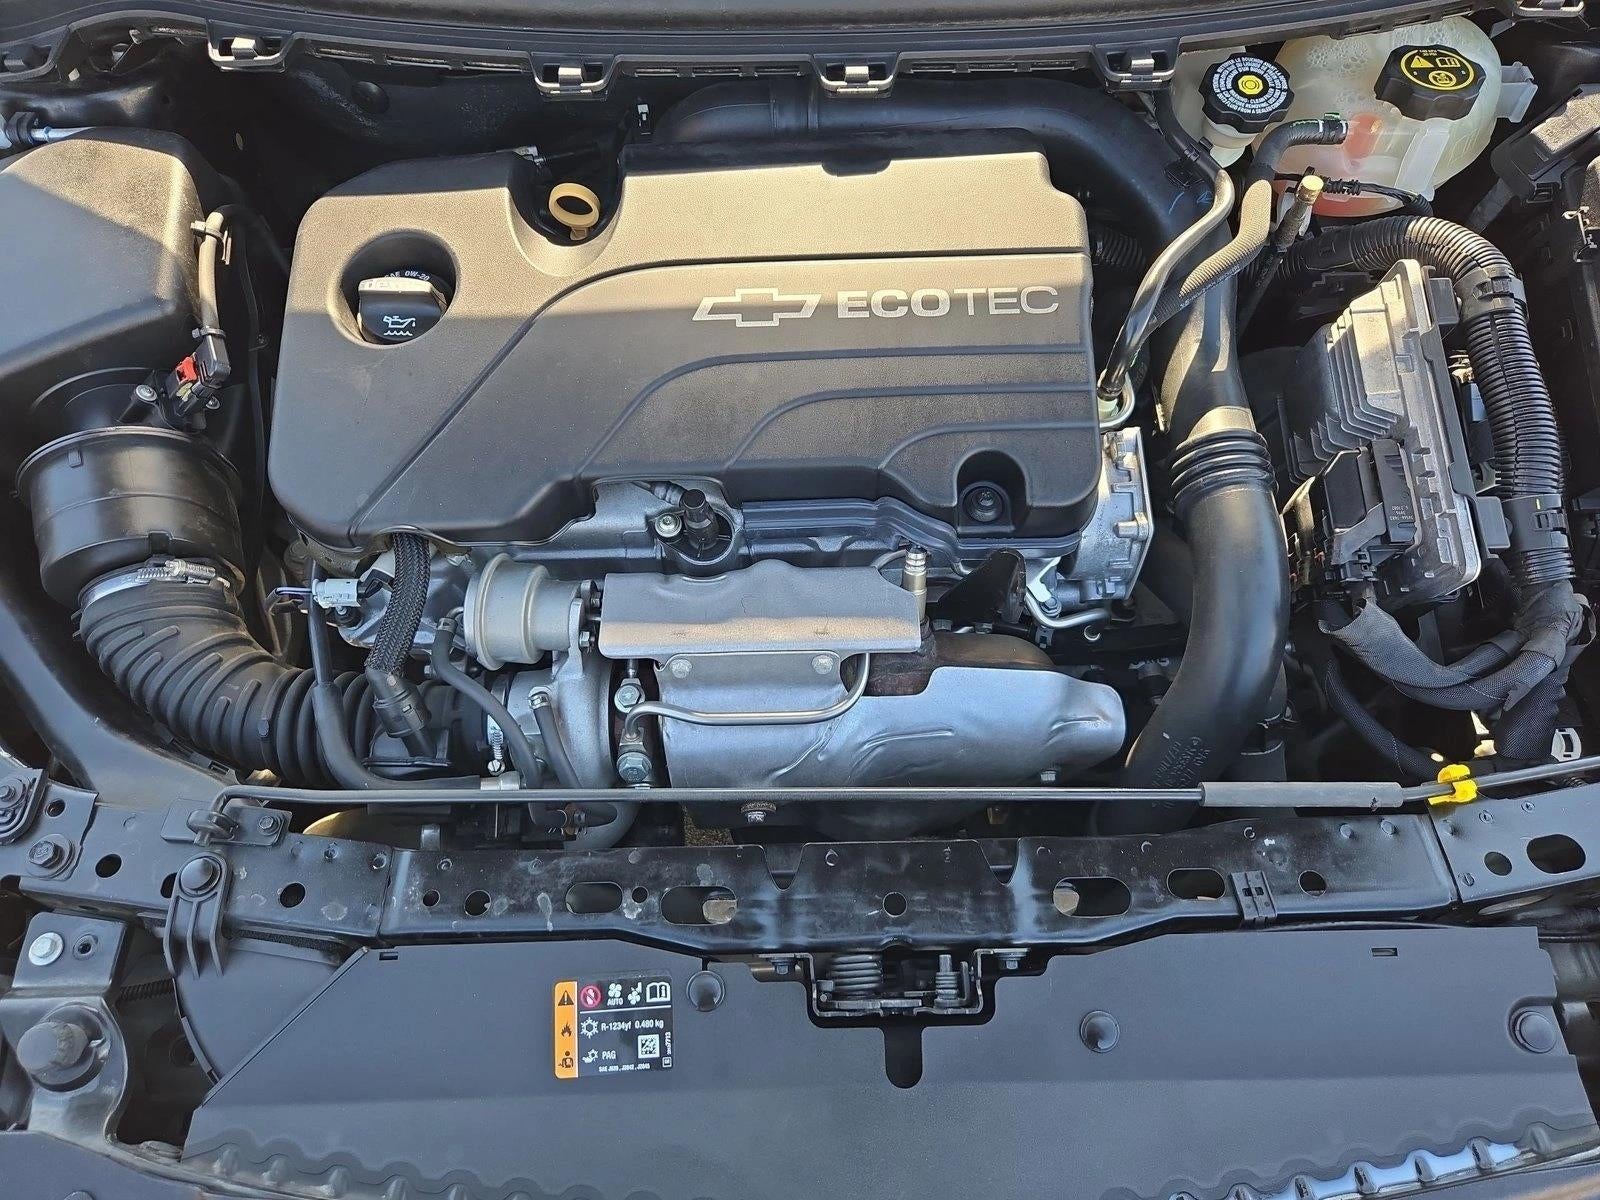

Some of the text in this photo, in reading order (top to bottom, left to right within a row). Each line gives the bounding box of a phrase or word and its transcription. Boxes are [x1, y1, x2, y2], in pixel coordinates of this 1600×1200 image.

[404, 270, 430, 281] 0W-20
[837, 286, 1059, 318] ECOTEC
[607, 998, 624, 1006] AUTO
[601, 1021, 632, 1031] R-1234yf
[655, 1019, 664, 1029] kg
[602, 1050, 616, 1060] PAG
